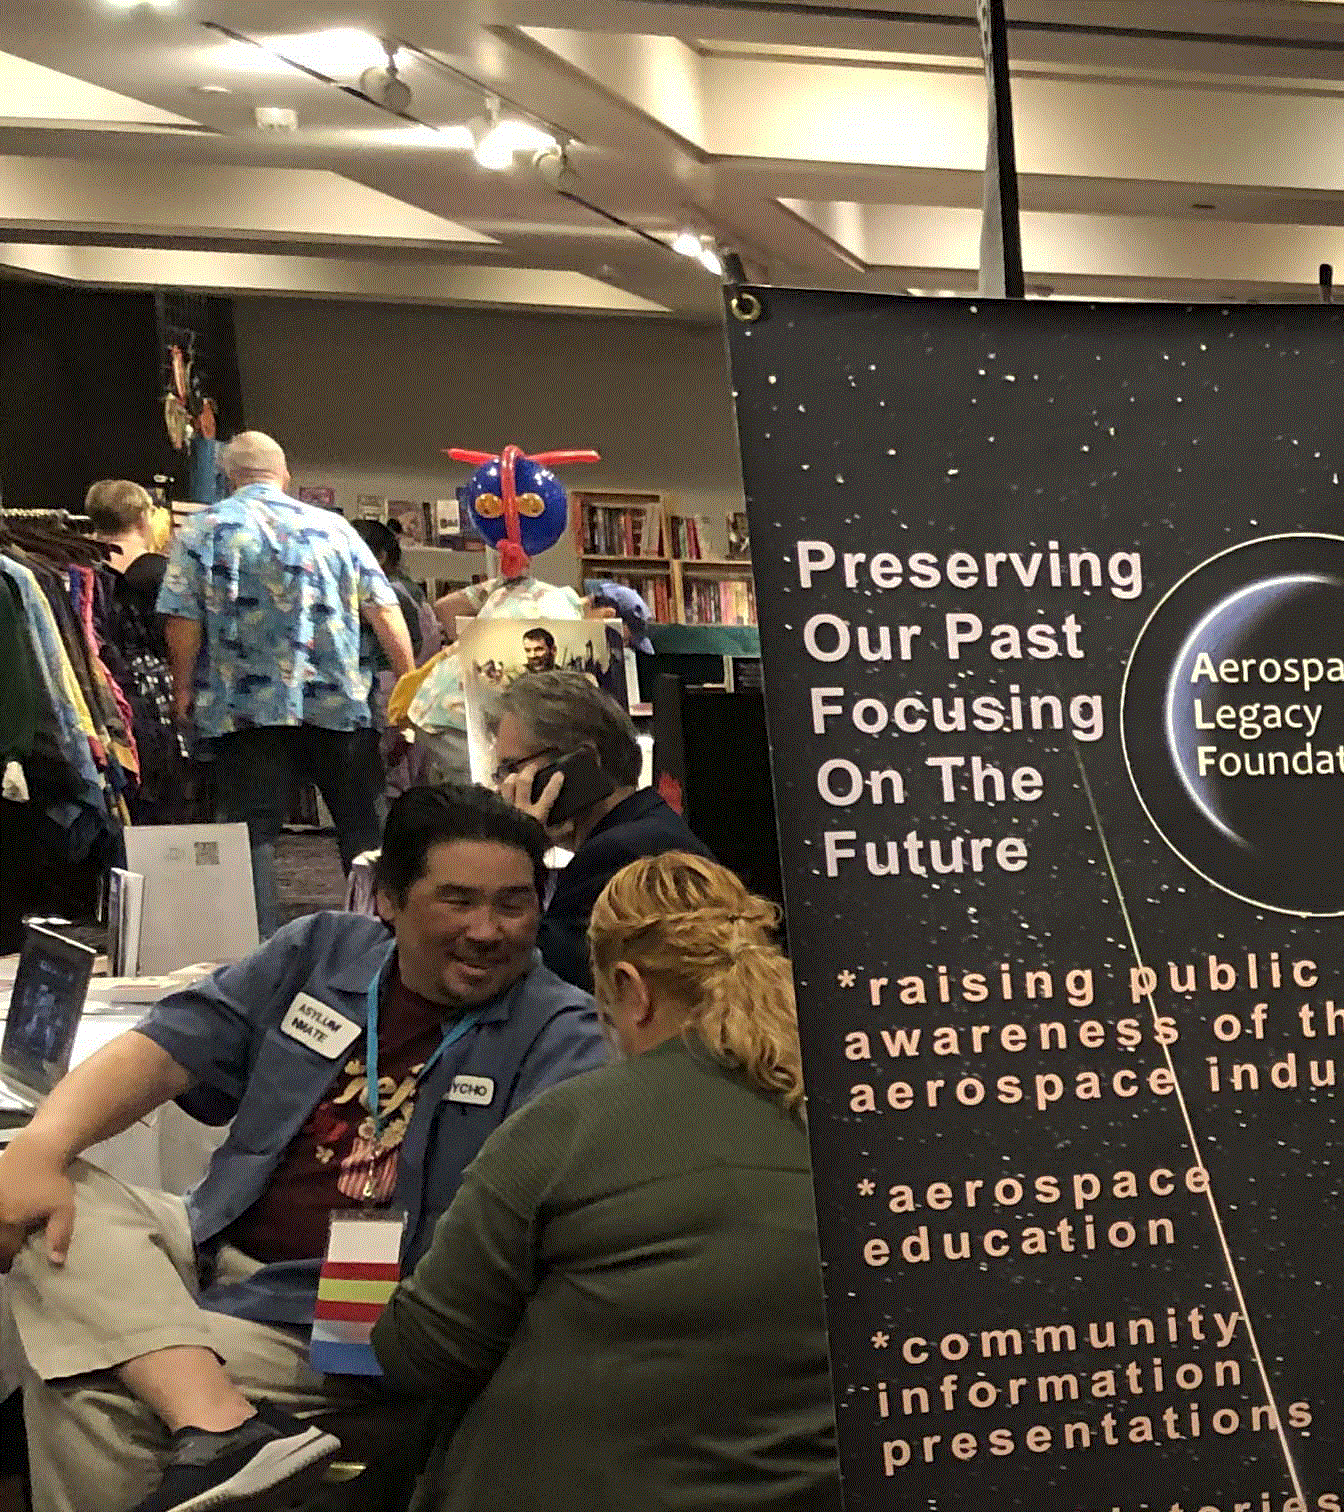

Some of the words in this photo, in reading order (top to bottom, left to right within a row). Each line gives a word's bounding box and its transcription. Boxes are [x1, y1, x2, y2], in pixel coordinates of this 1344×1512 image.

[796, 540, 1143, 600] Preserving
[803, 613, 922, 662] Our
[945, 612, 1085, 661] Past
[810, 687, 1104, 742] Focusing
[1193, 697, 1322, 739] Legacy
[817, 758, 905, 806] On
[925, 755, 1044, 803] The
[823, 830, 1028, 878] Future
[1129, 952, 1319, 999] public
[845, 1012, 1179, 1060] awareness
[1213, 1003, 1268, 1041] of
[451, 1082, 488, 1096] YCHO
[850, 1064, 1177, 1113] aerospace
[864, 1215, 1176, 1266] education
[877, 1357, 1242, 1419] information
[883, 1397, 1313, 1476] presentations
